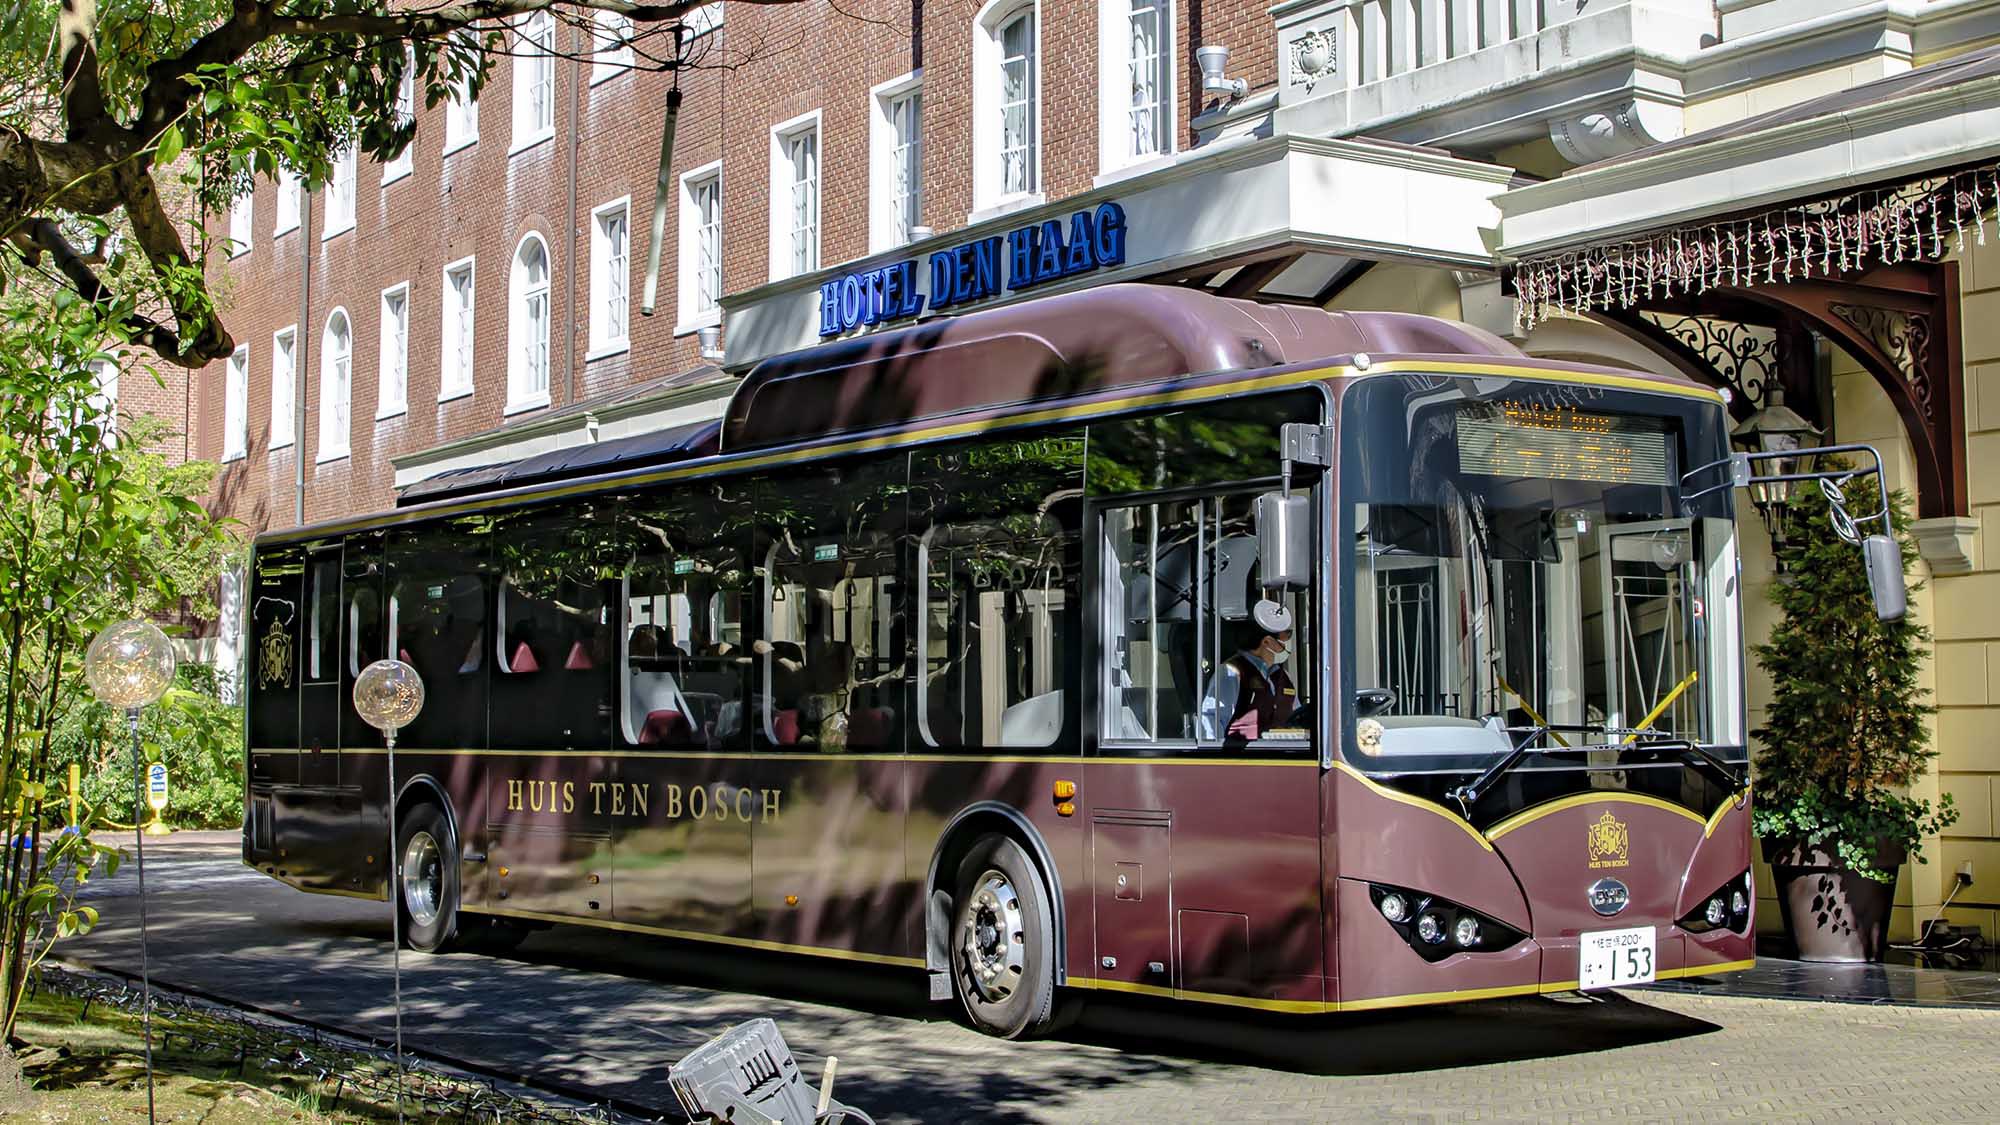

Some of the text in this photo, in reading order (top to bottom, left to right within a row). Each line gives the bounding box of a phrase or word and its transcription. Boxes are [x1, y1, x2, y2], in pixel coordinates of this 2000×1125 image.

[819, 202, 1127, 337] HOTEL DEN HAAG
[507, 779, 781, 824] HUIS TEN BOSCH
[1588, 861, 1601, 869] HUIS
[1602, 860, 1611, 868] TEN
